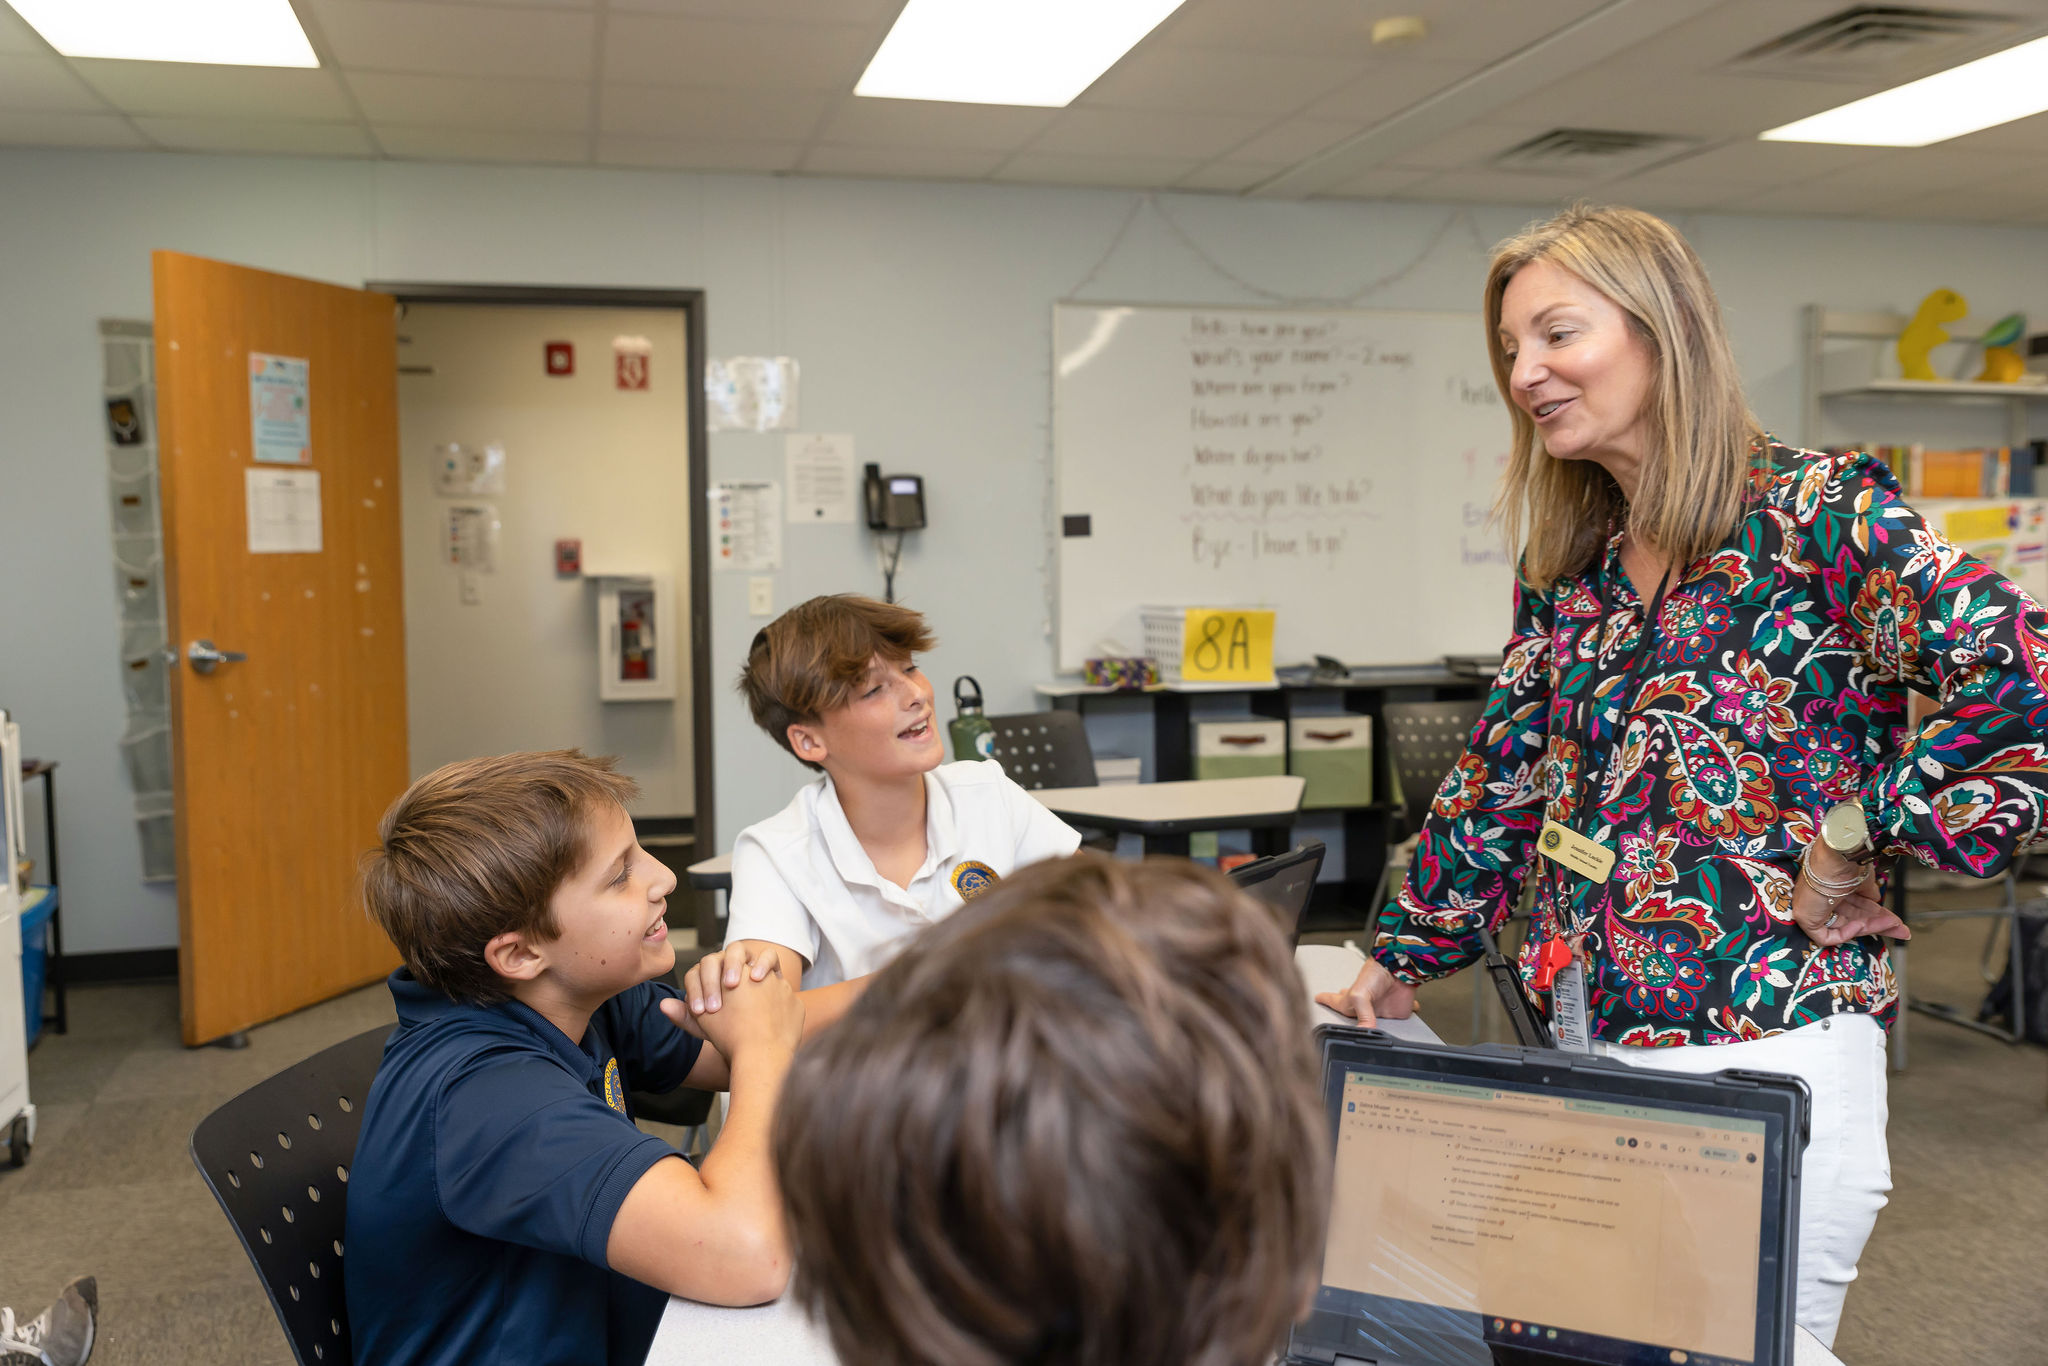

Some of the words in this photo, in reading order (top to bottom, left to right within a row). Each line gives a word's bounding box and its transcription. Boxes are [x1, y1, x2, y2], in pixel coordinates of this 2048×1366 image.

[1360, 346, 1375, 367] 2
[1190, 482, 1233, 508] What
[1193, 615, 1251, 673] 8A
